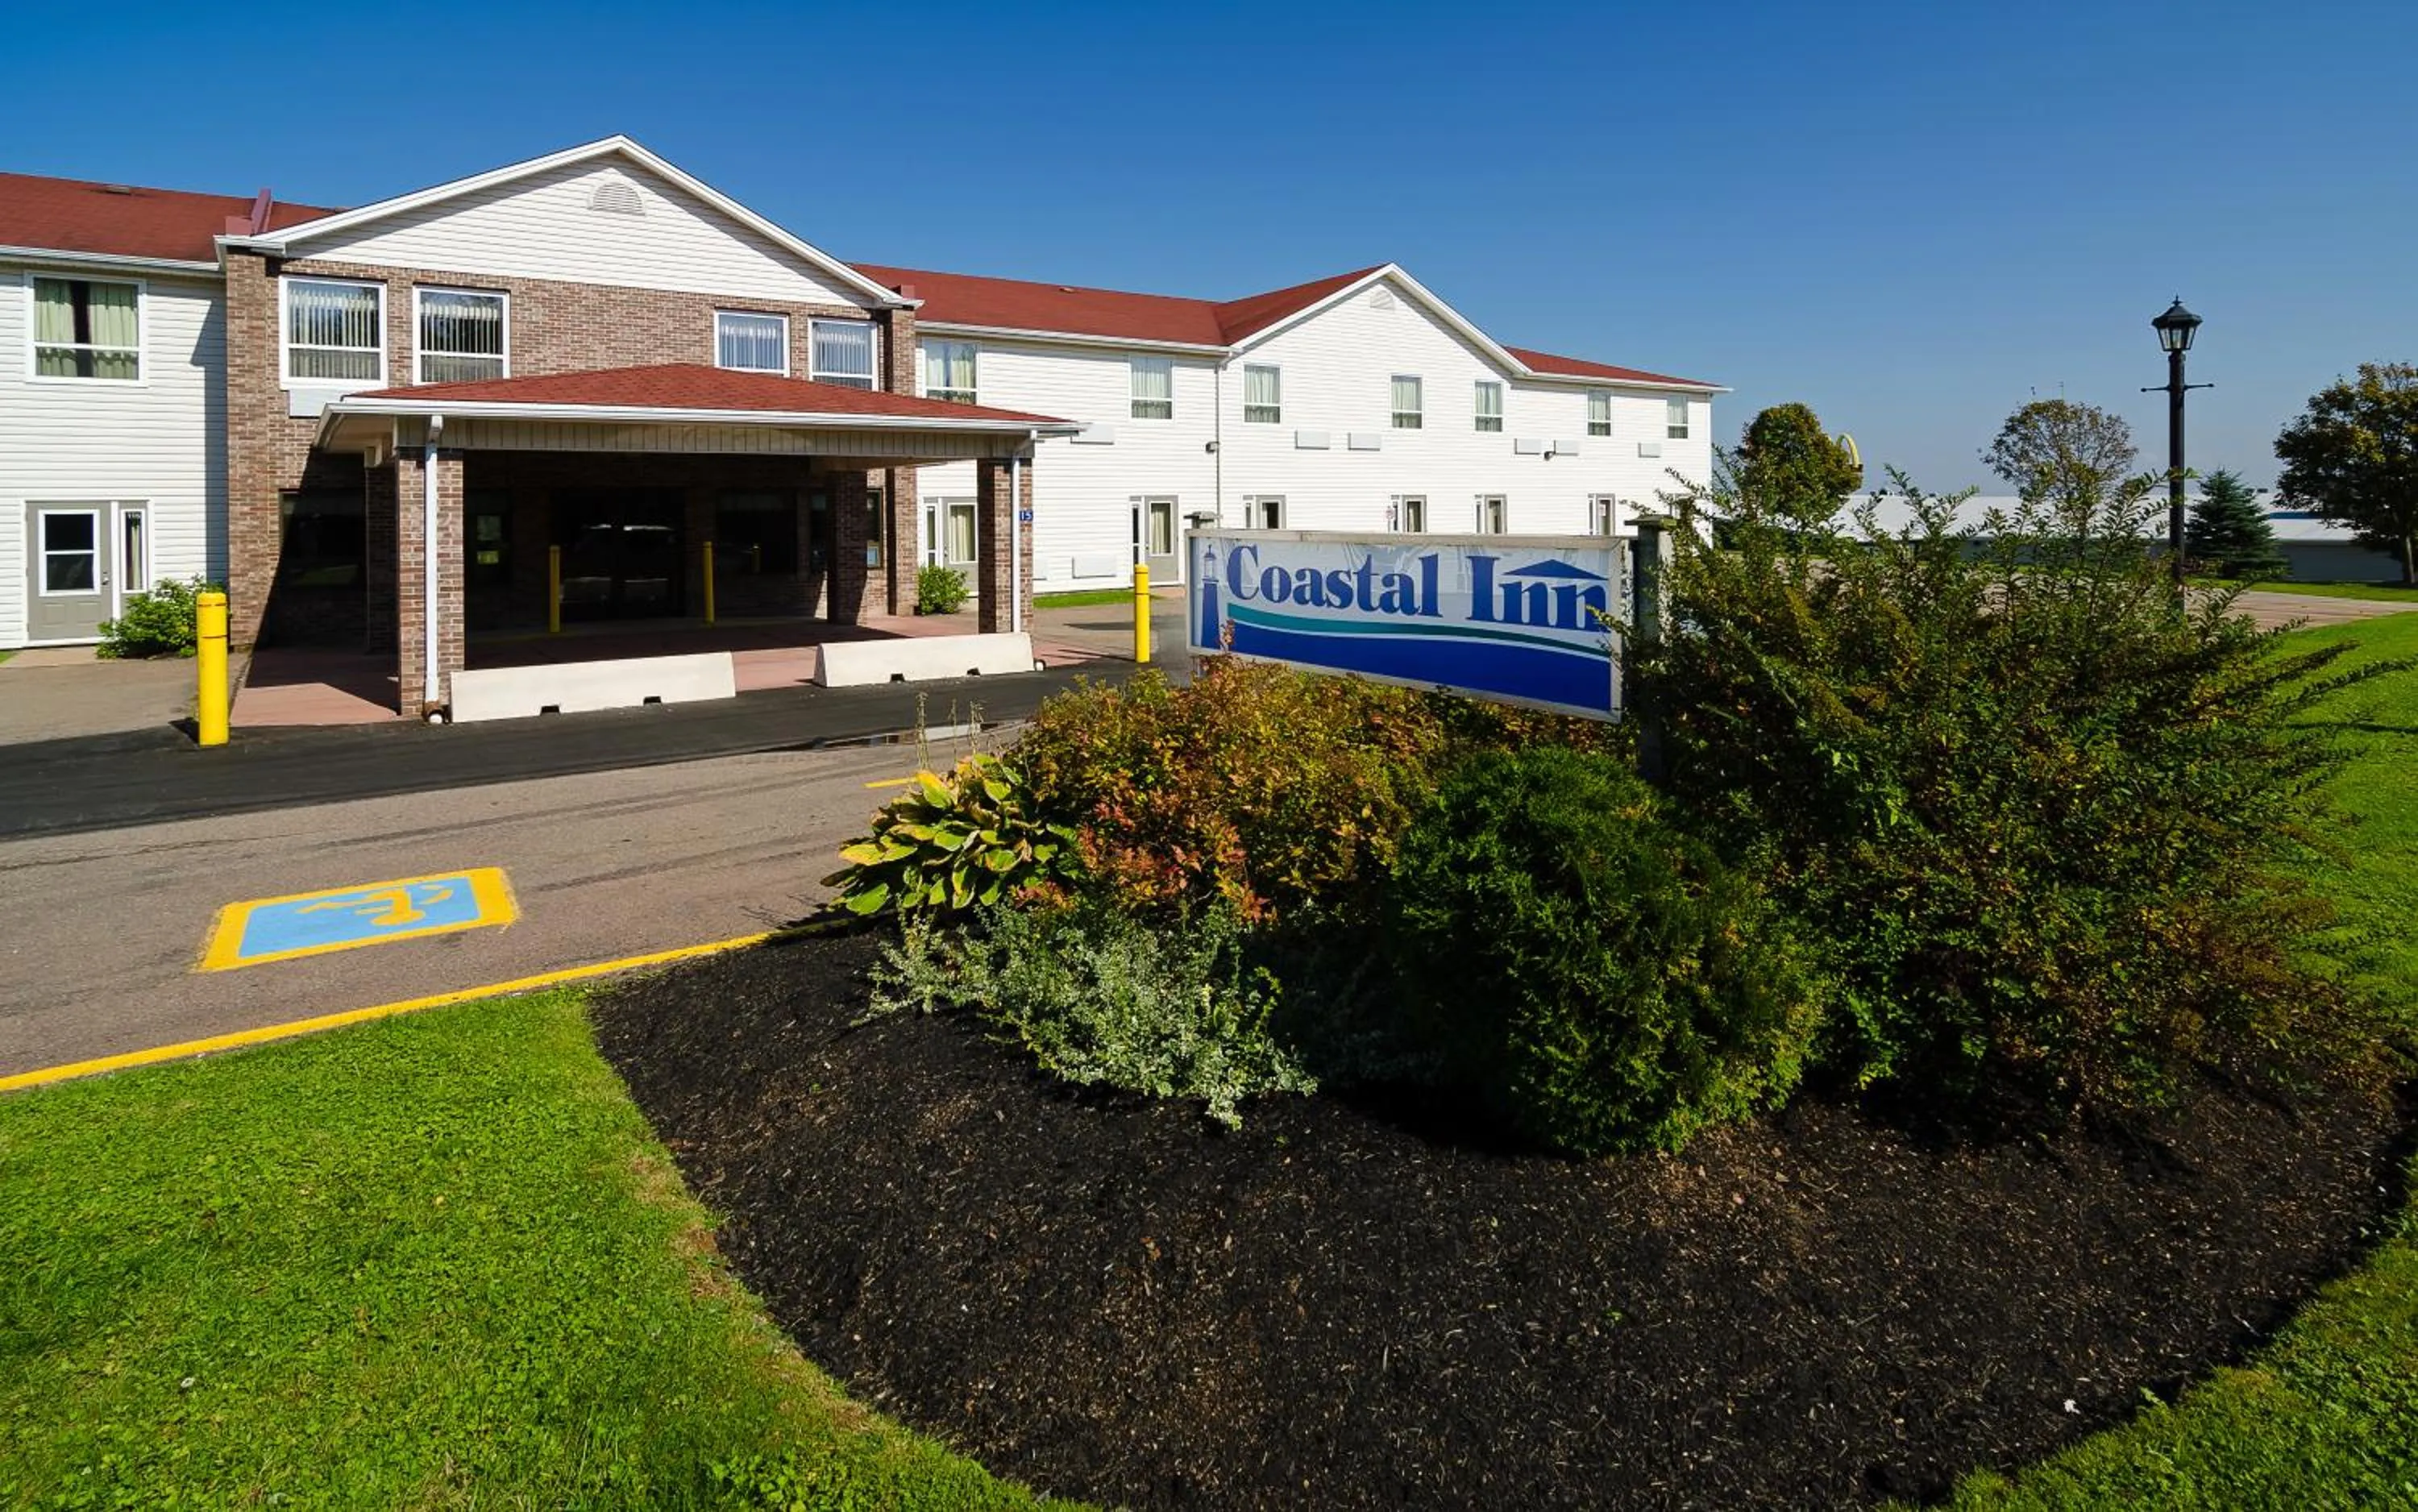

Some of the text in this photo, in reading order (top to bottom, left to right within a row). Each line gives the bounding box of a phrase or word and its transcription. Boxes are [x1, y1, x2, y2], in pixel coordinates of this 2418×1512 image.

[1020, 511, 1032, 521] 15
[1227, 545, 1610, 633] Coastal Inn
